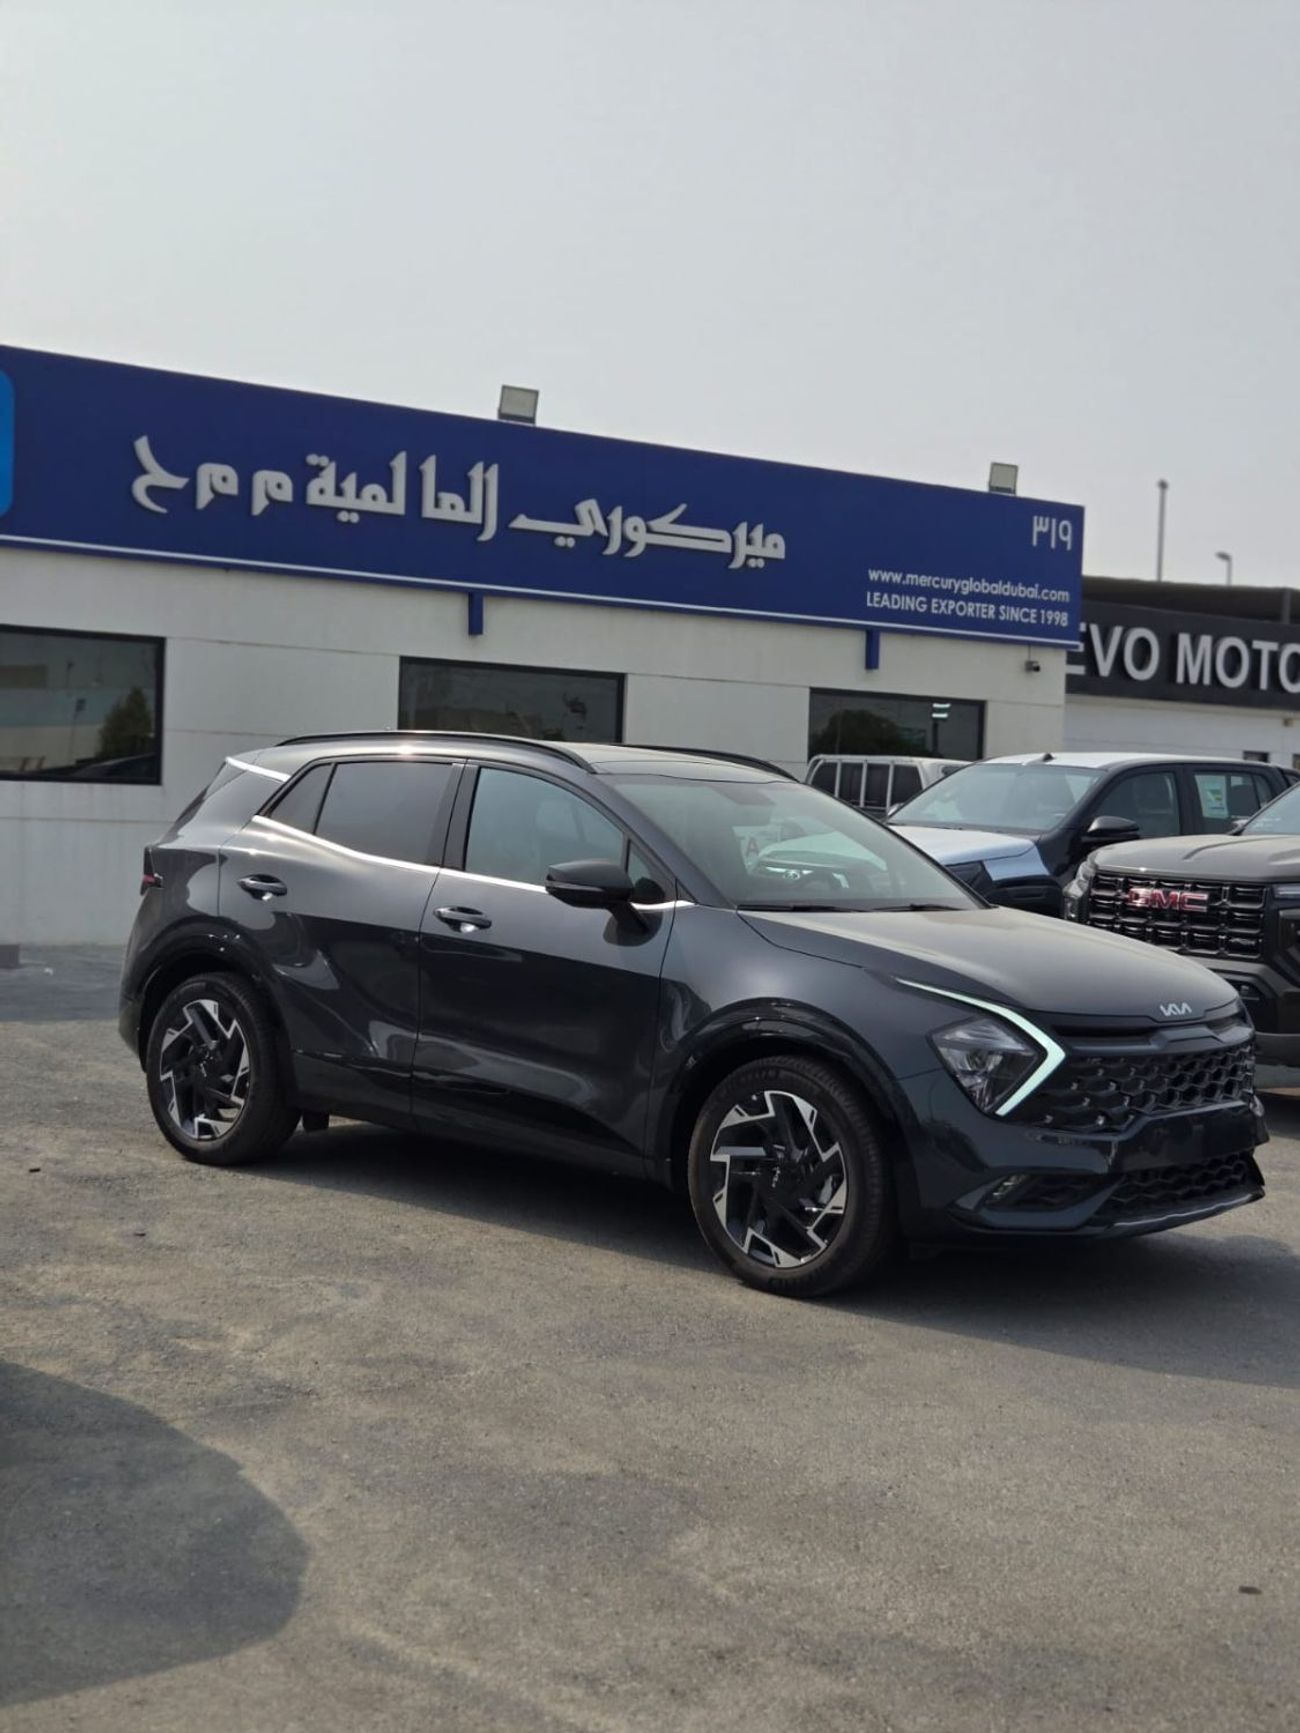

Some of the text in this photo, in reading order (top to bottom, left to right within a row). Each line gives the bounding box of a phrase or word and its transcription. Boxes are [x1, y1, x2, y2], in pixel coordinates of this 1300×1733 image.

[508, 498, 786, 569] ميركوري
[868, 568, 1070, 603] www.mercuryglobaldubai.com
[866, 591, 1068, 627] LEADING EXPORTER SINCE 1998
[1127, 887, 1209, 913] GMC
